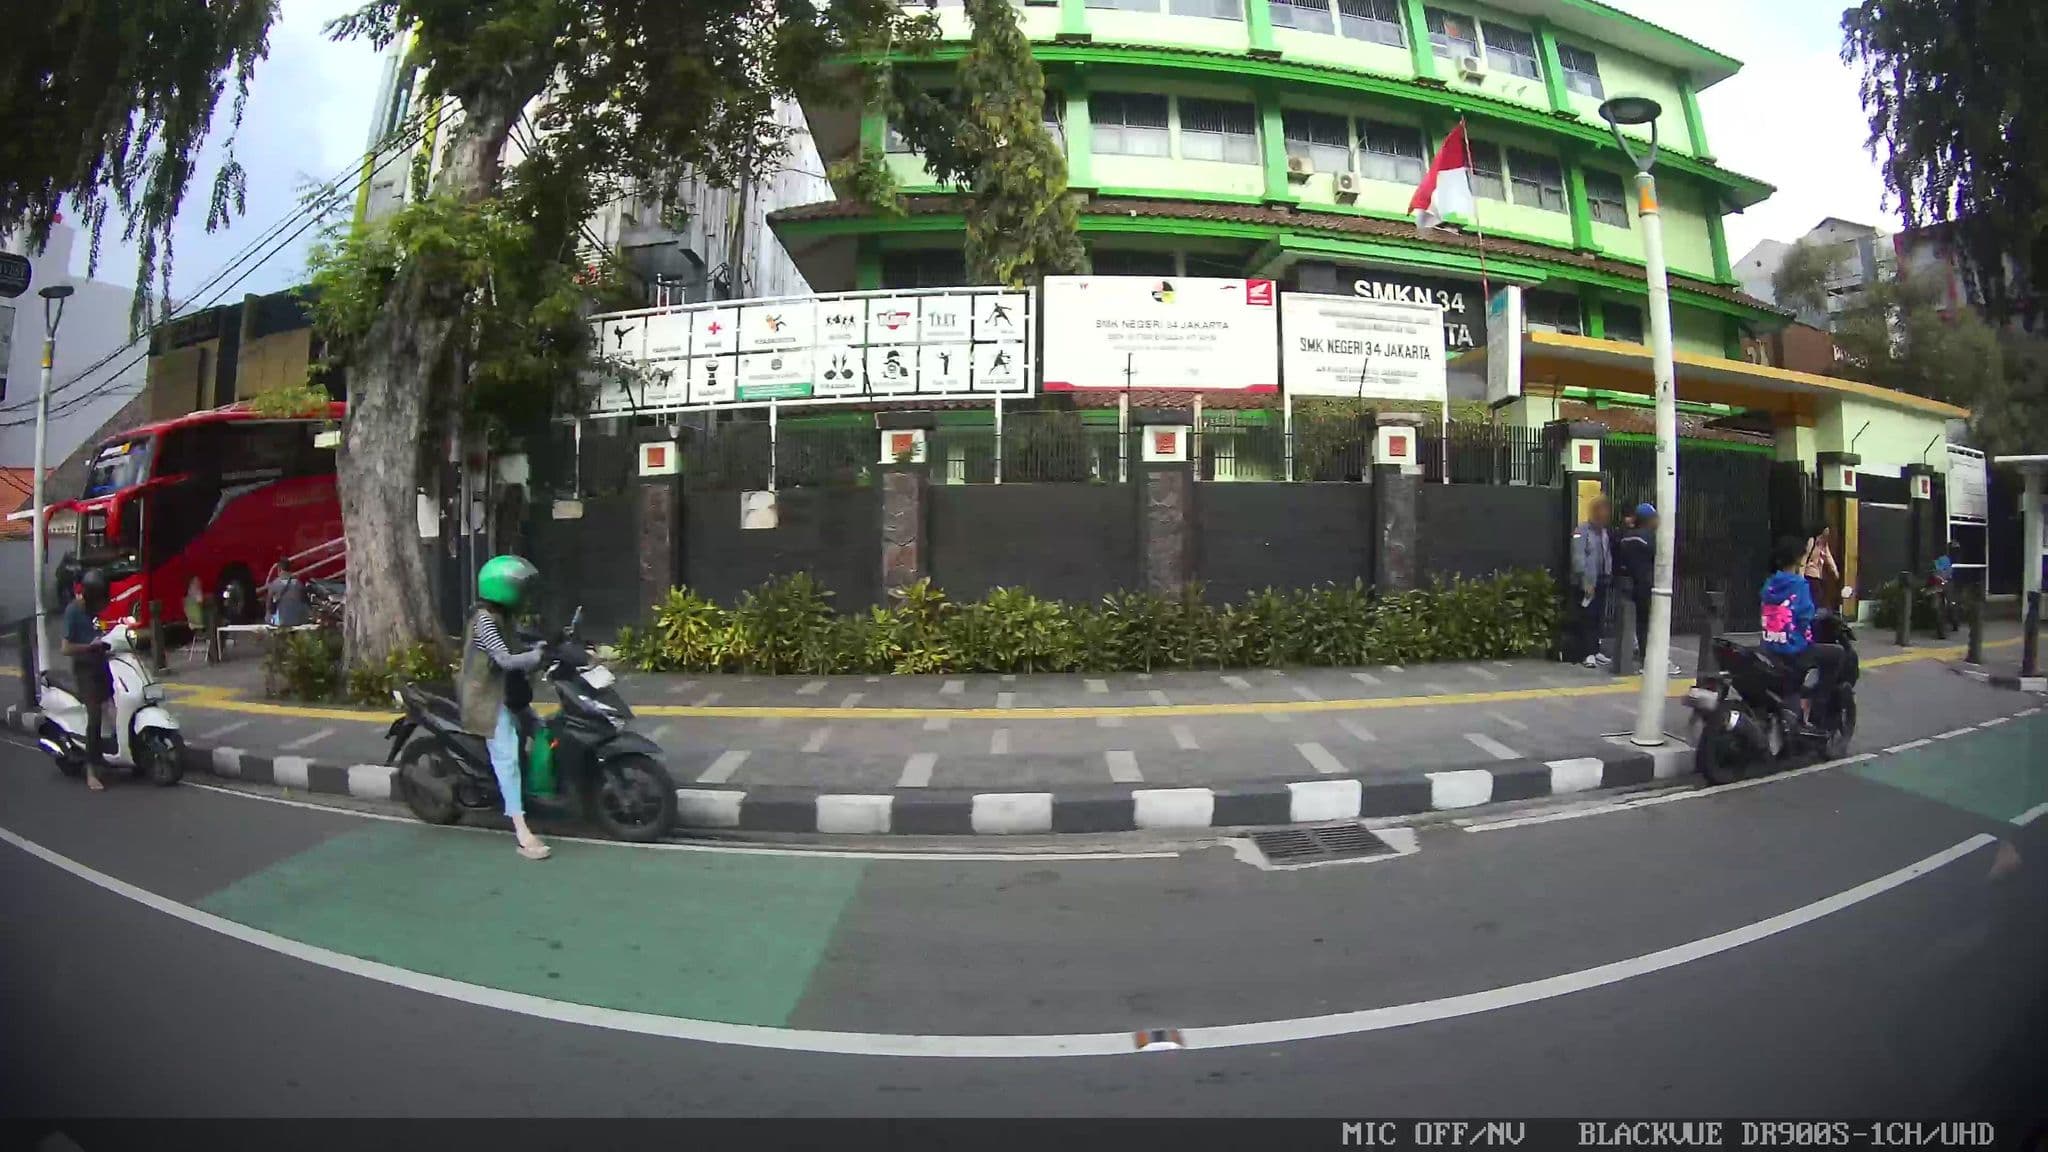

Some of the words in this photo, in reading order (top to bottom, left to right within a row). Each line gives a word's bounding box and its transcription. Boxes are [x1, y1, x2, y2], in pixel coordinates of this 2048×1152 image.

[1353, 279, 1432, 305] SMKN
[1436, 290, 1466, 314] 34
[1181, 321, 1230, 329] JAKARTA
[1300, 337, 1324, 353] SMK
[1327, 339, 1363, 355] NEGERI
[1365, 341, 1382, 356] 34
[1384, 343, 1432, 360] JAKARTA
